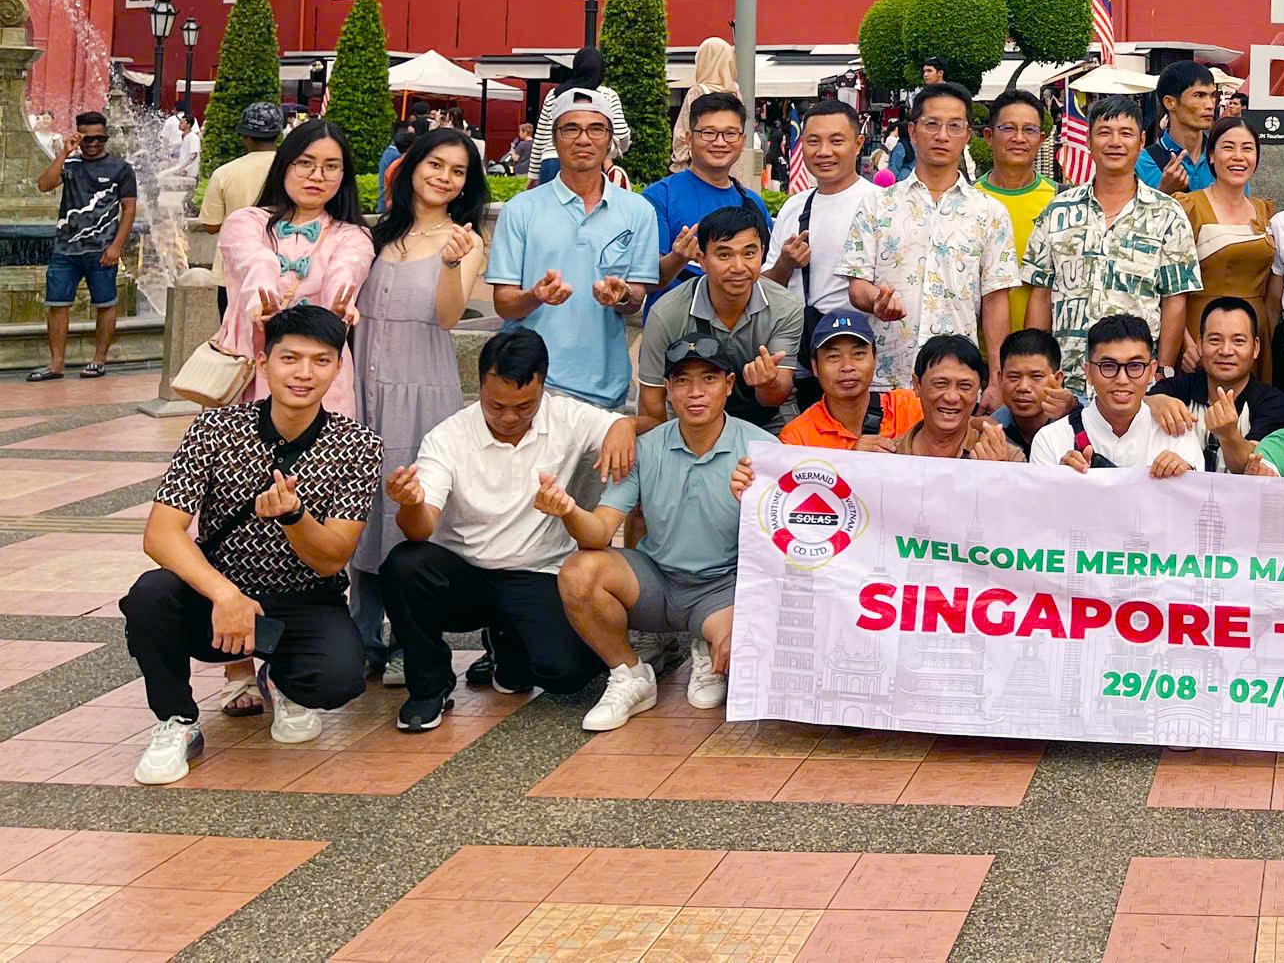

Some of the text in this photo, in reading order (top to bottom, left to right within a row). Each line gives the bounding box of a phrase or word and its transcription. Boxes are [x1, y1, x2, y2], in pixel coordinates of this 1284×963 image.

[795, 471, 835, 486] MERMAID
[769, 489, 783, 530] MARITIME
[796, 514, 832, 525] SOLAS
[844, 497, 857, 532] VIETNAM
[895, 536, 1065, 573] WELCOME
[1076, 550, 1239, 579] MERMAID
[855, 582, 1251, 649] SINGAPORE
[1102, 669, 1197, 702] 29/08
[1207, 685, 1218, 693] -
